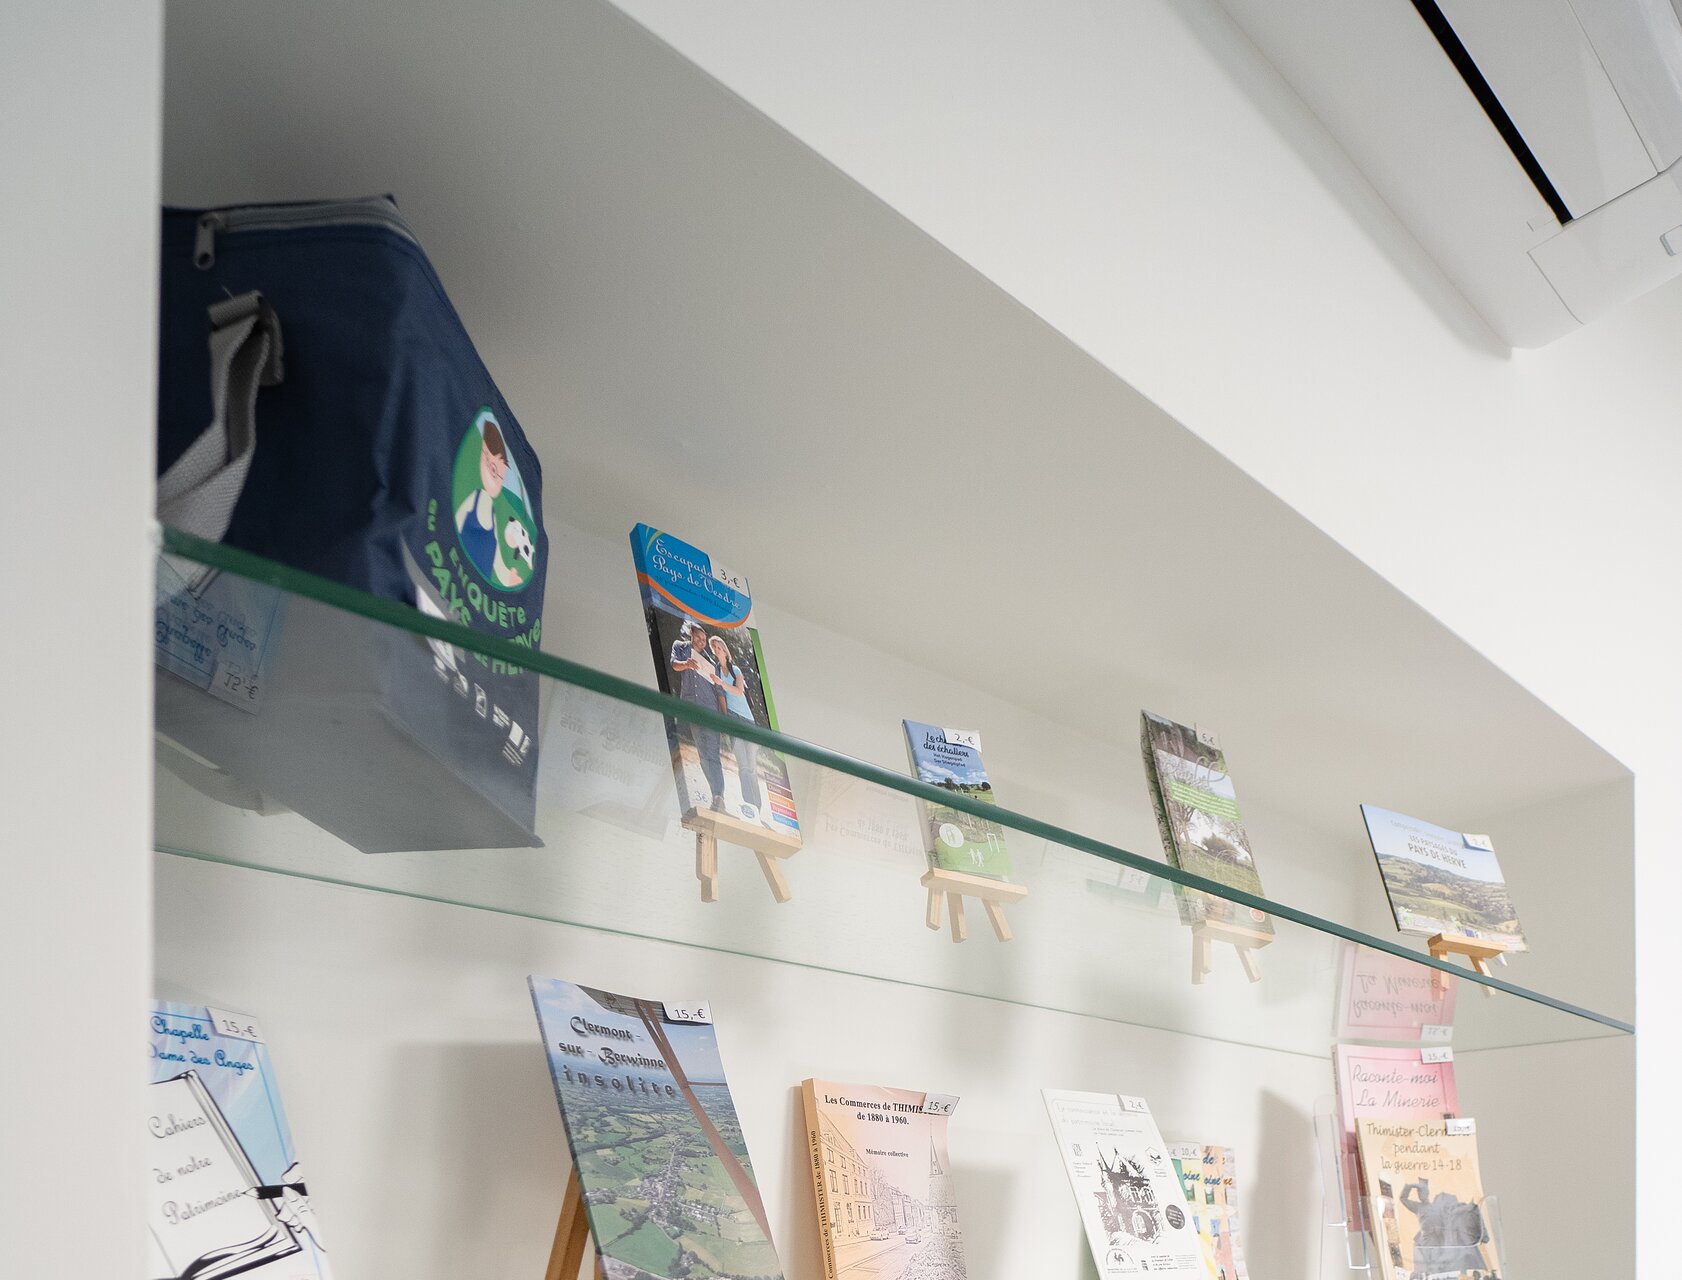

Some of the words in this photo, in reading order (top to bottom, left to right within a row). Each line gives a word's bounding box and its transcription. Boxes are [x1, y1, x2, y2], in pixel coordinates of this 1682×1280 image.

[652, 555, 683, 583] Pays
[674, 1007, 706, 1021] 15,-€
[570, 1014, 634, 1042] Clermont
[214, 1049, 255, 1076] Anges
[559, 1041, 583, 1056] sur
[597, 1046, 666, 1070] Berwinne
[1352, 1063, 1439, 1084] Raconte-moi
[824, 1094, 838, 1105] Les
[839, 1096, 881, 1111] Commerces
[882, 1101, 891, 1111] de
[1356, 1088, 1377, 1107] La
[1382, 1090, 1441, 1108] Minerie
[856, 1111, 866, 1121] de
[867, 1112, 884, 1123] 1880
[1392, 1141, 1441, 1157] pendant
[1381, 1156, 1392, 1169] la
[1394, 1160, 1431, 1174] guerre
[1432, 1159, 1462, 1171] 14-18
